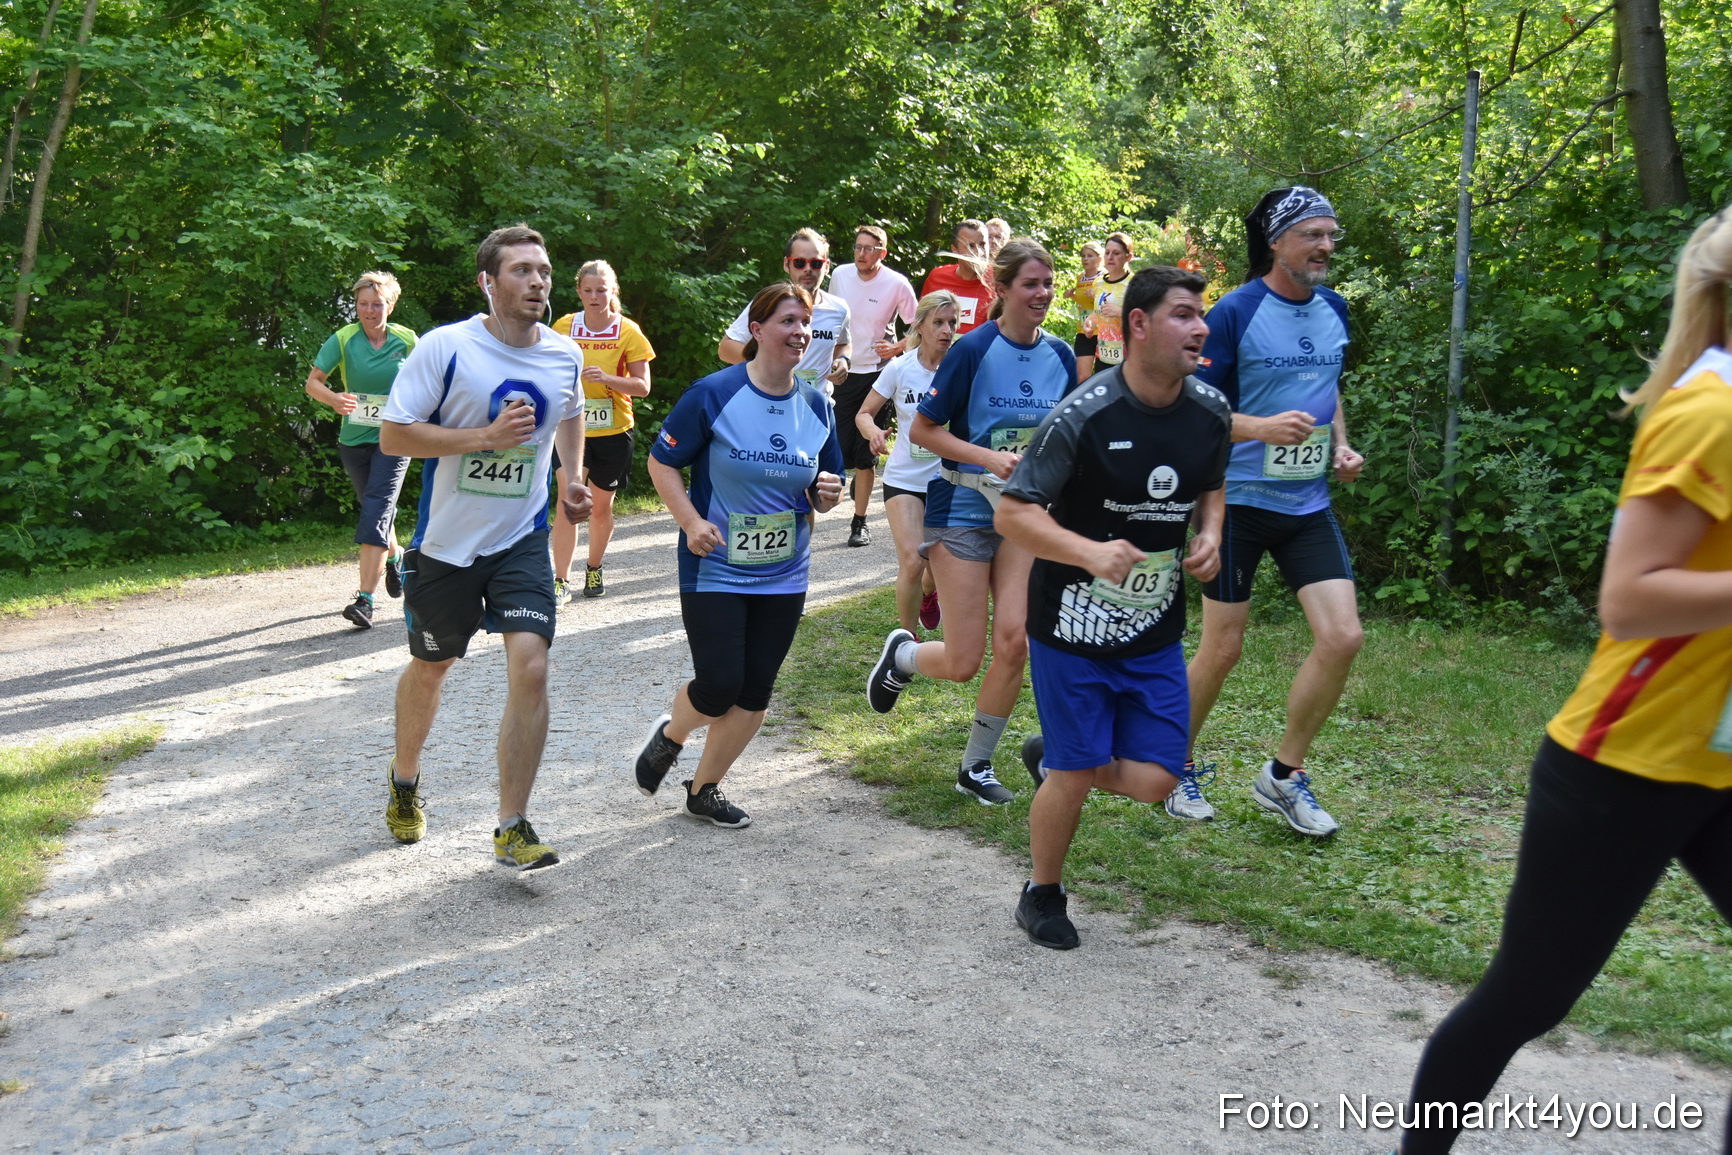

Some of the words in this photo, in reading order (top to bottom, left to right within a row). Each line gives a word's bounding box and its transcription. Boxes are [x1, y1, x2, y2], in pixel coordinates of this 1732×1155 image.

[593, 342, 619, 350] BÖGL
[1100, 347, 1120, 359] 1318
[1297, 372, 1319, 381] TEAM
[1018, 413, 1037, 421] TEAM
[1273, 444, 1324, 465] 2123
[468, 459, 524, 484] 2441
[764, 468, 788, 478] TEAM
[736, 530, 788, 551] 2122
[504, 606, 549, 624] waitrose
